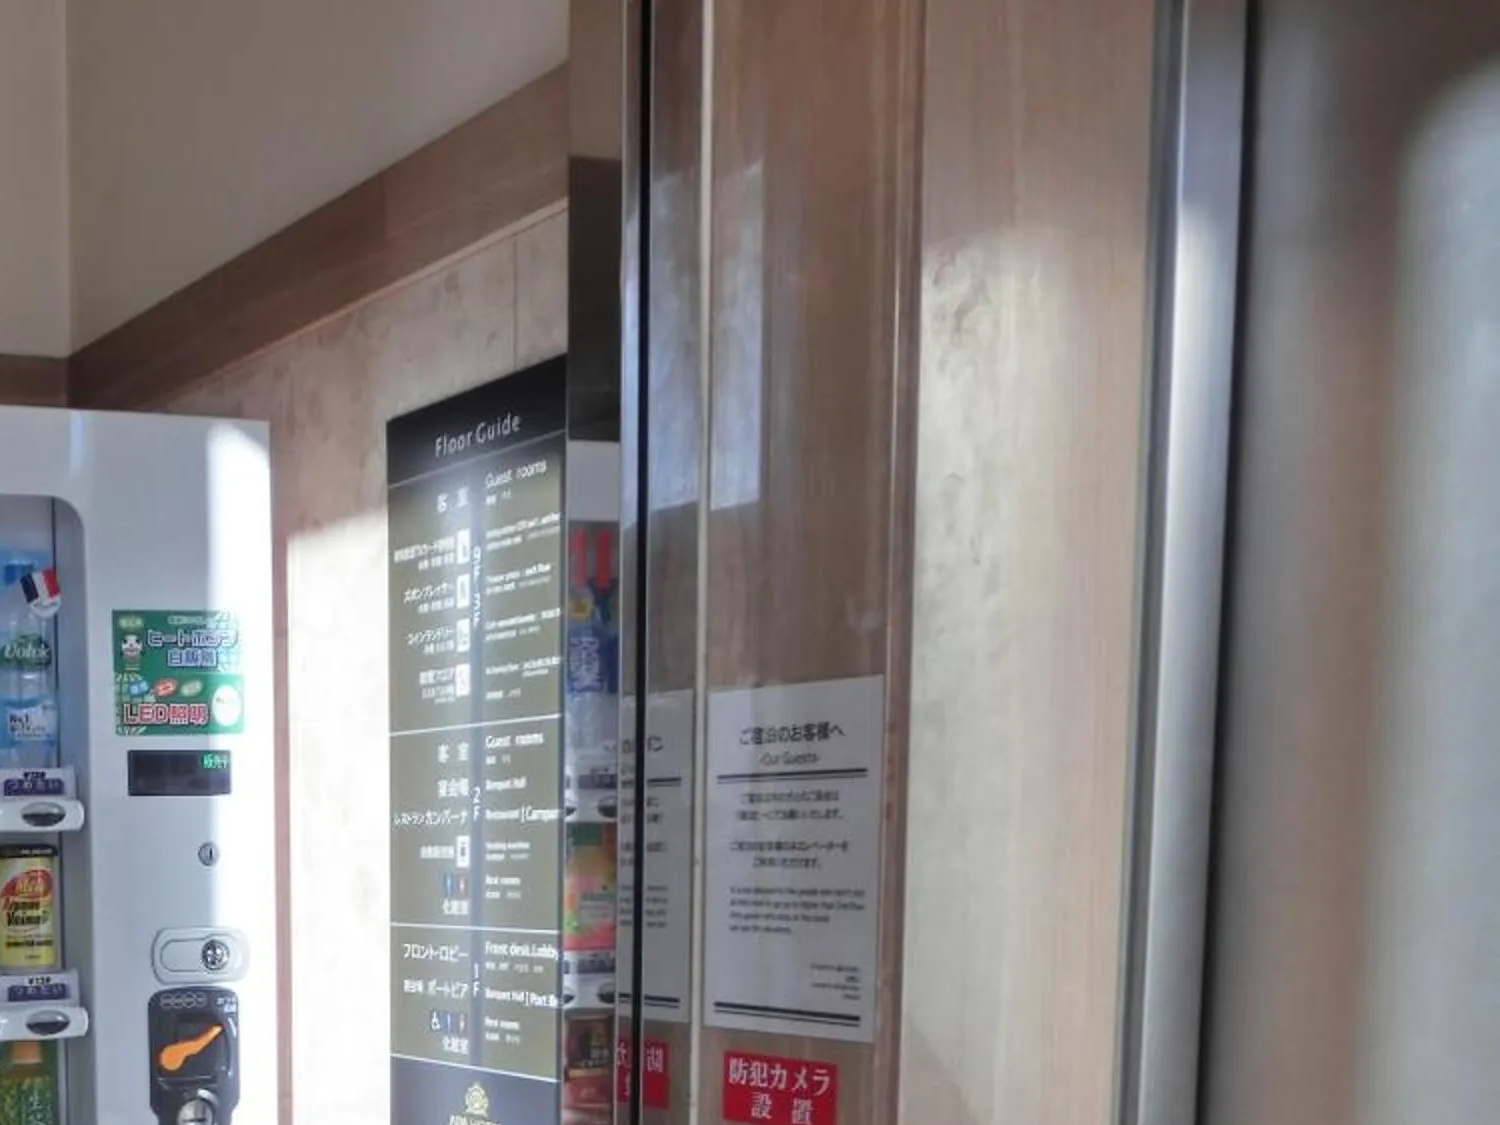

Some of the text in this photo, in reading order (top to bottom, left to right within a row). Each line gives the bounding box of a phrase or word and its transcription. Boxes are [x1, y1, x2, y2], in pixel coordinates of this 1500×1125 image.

[435, 412, 521, 458] Floor Guide
[728, 1057, 831, 1096] 防犯カメラ
